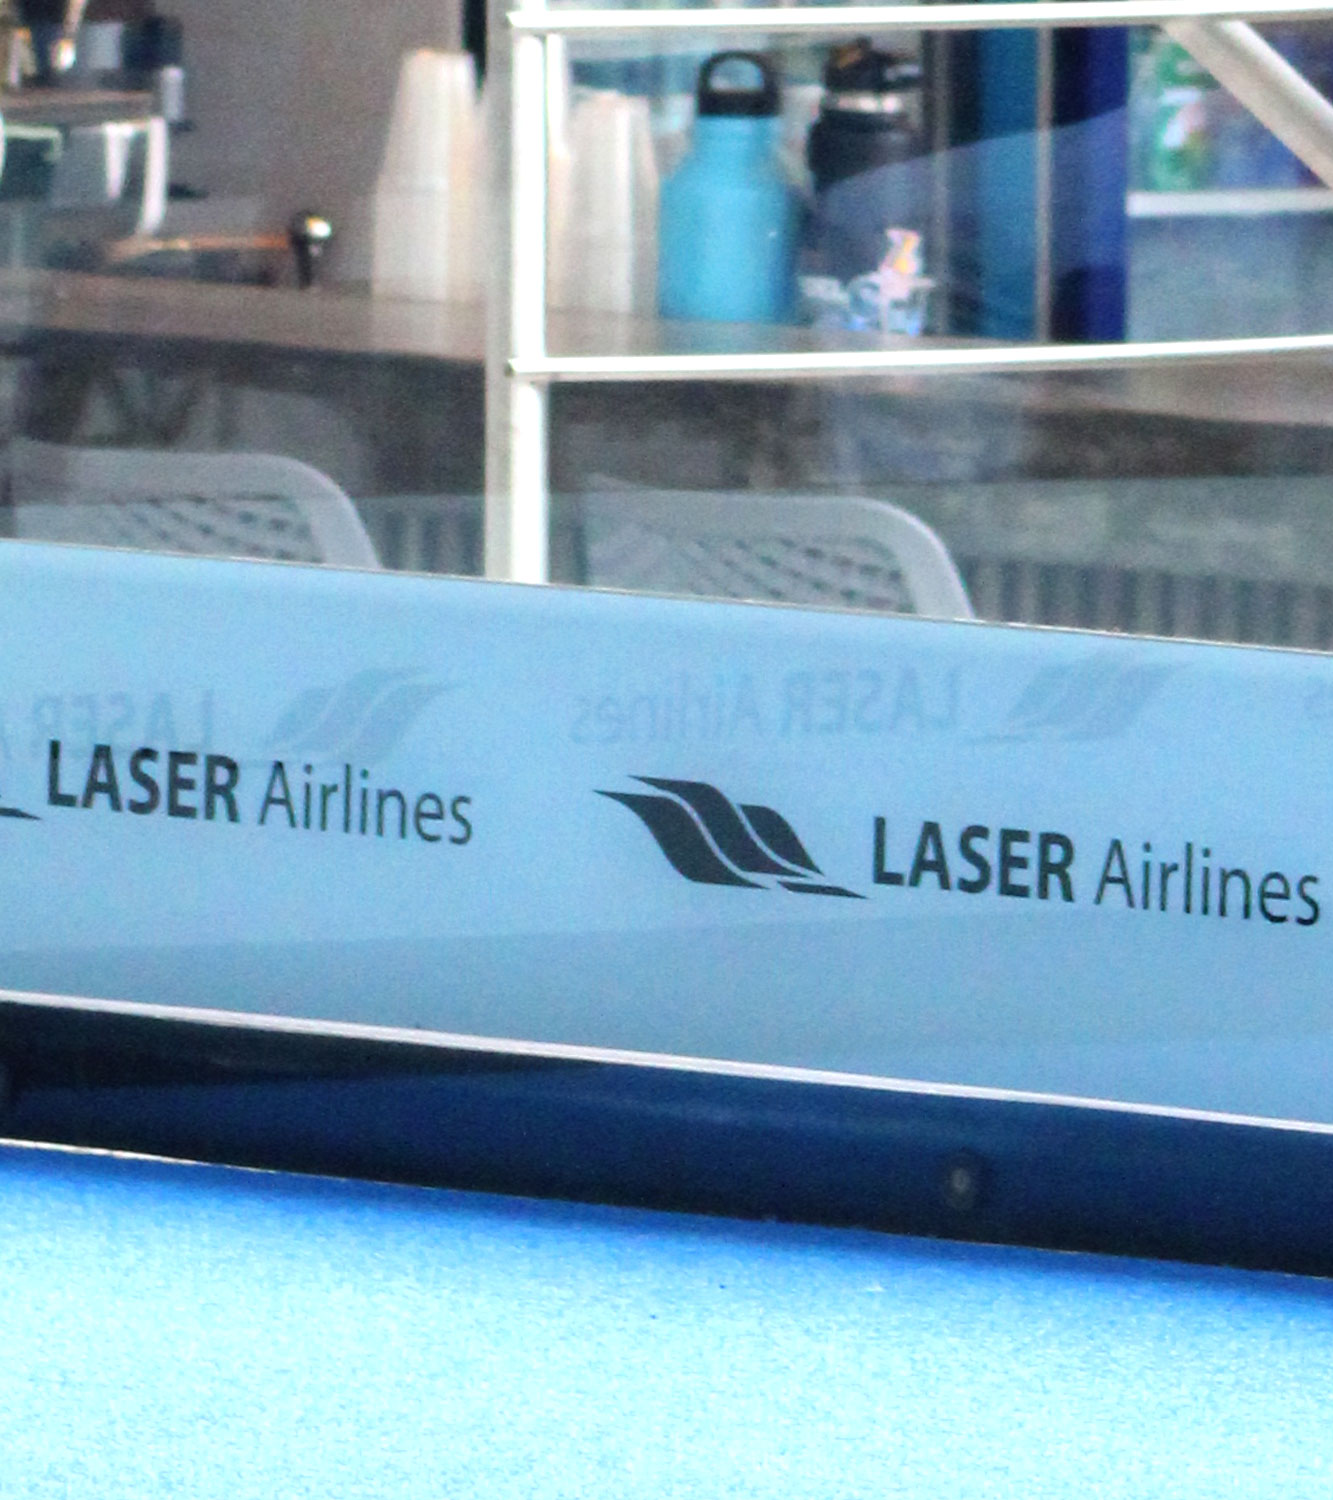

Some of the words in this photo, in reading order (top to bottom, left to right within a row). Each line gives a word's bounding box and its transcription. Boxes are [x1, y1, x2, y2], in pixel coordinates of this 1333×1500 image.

[49, 741, 238, 822] LASER
[261, 762, 471, 844] Airlines
[875, 817, 1074, 902] LASER
[1097, 841, 1320, 926] Airlines
